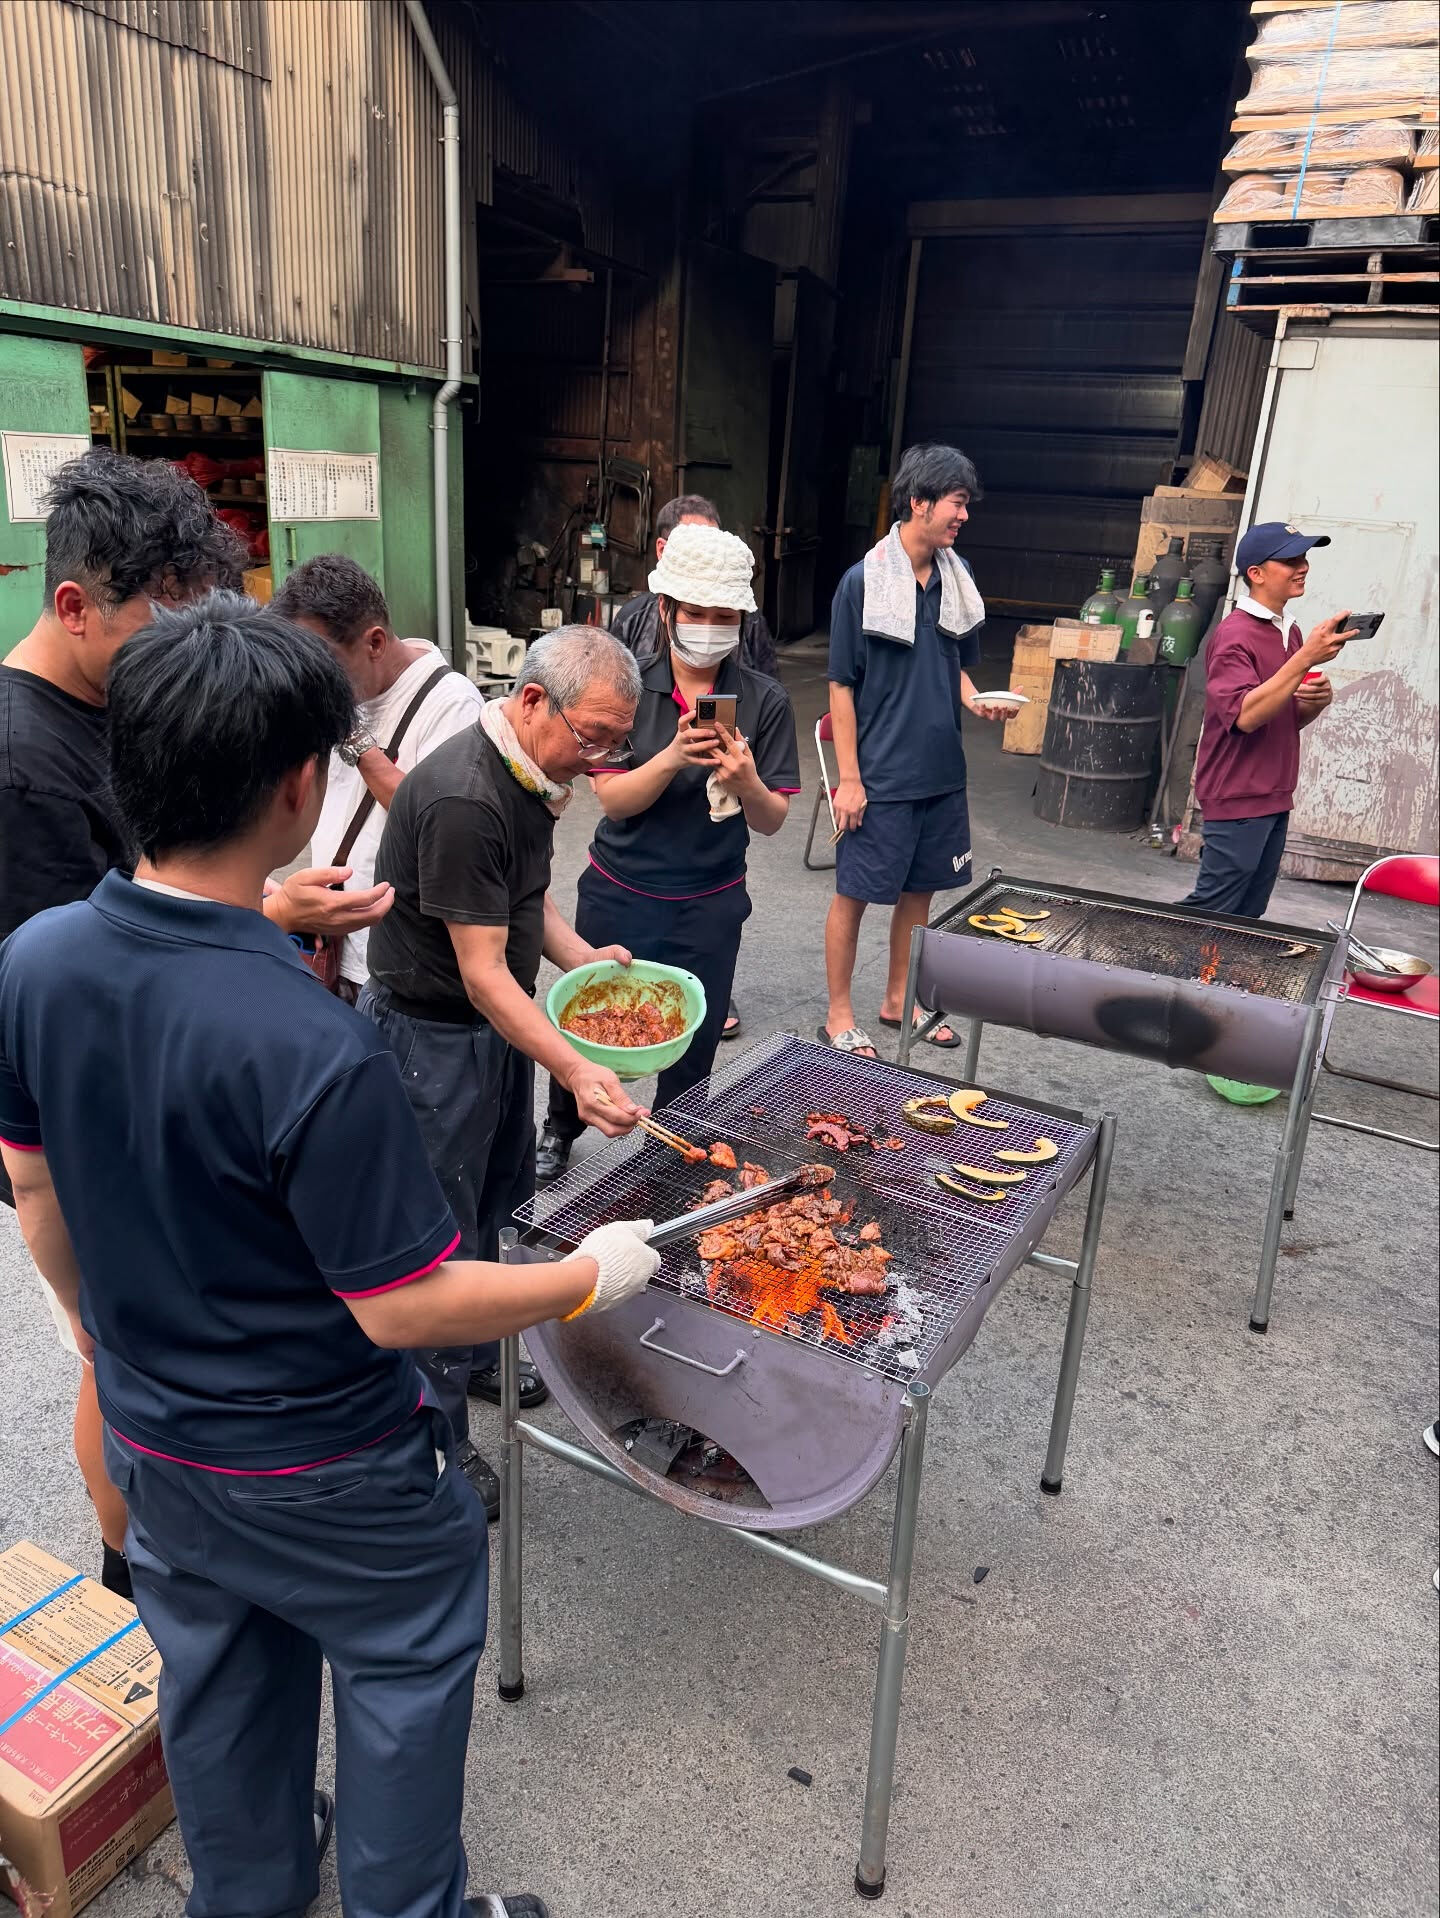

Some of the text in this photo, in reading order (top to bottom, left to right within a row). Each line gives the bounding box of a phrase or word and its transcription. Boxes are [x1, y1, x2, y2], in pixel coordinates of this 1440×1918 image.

[23, 1709, 89, 1757] バーベキュー用
